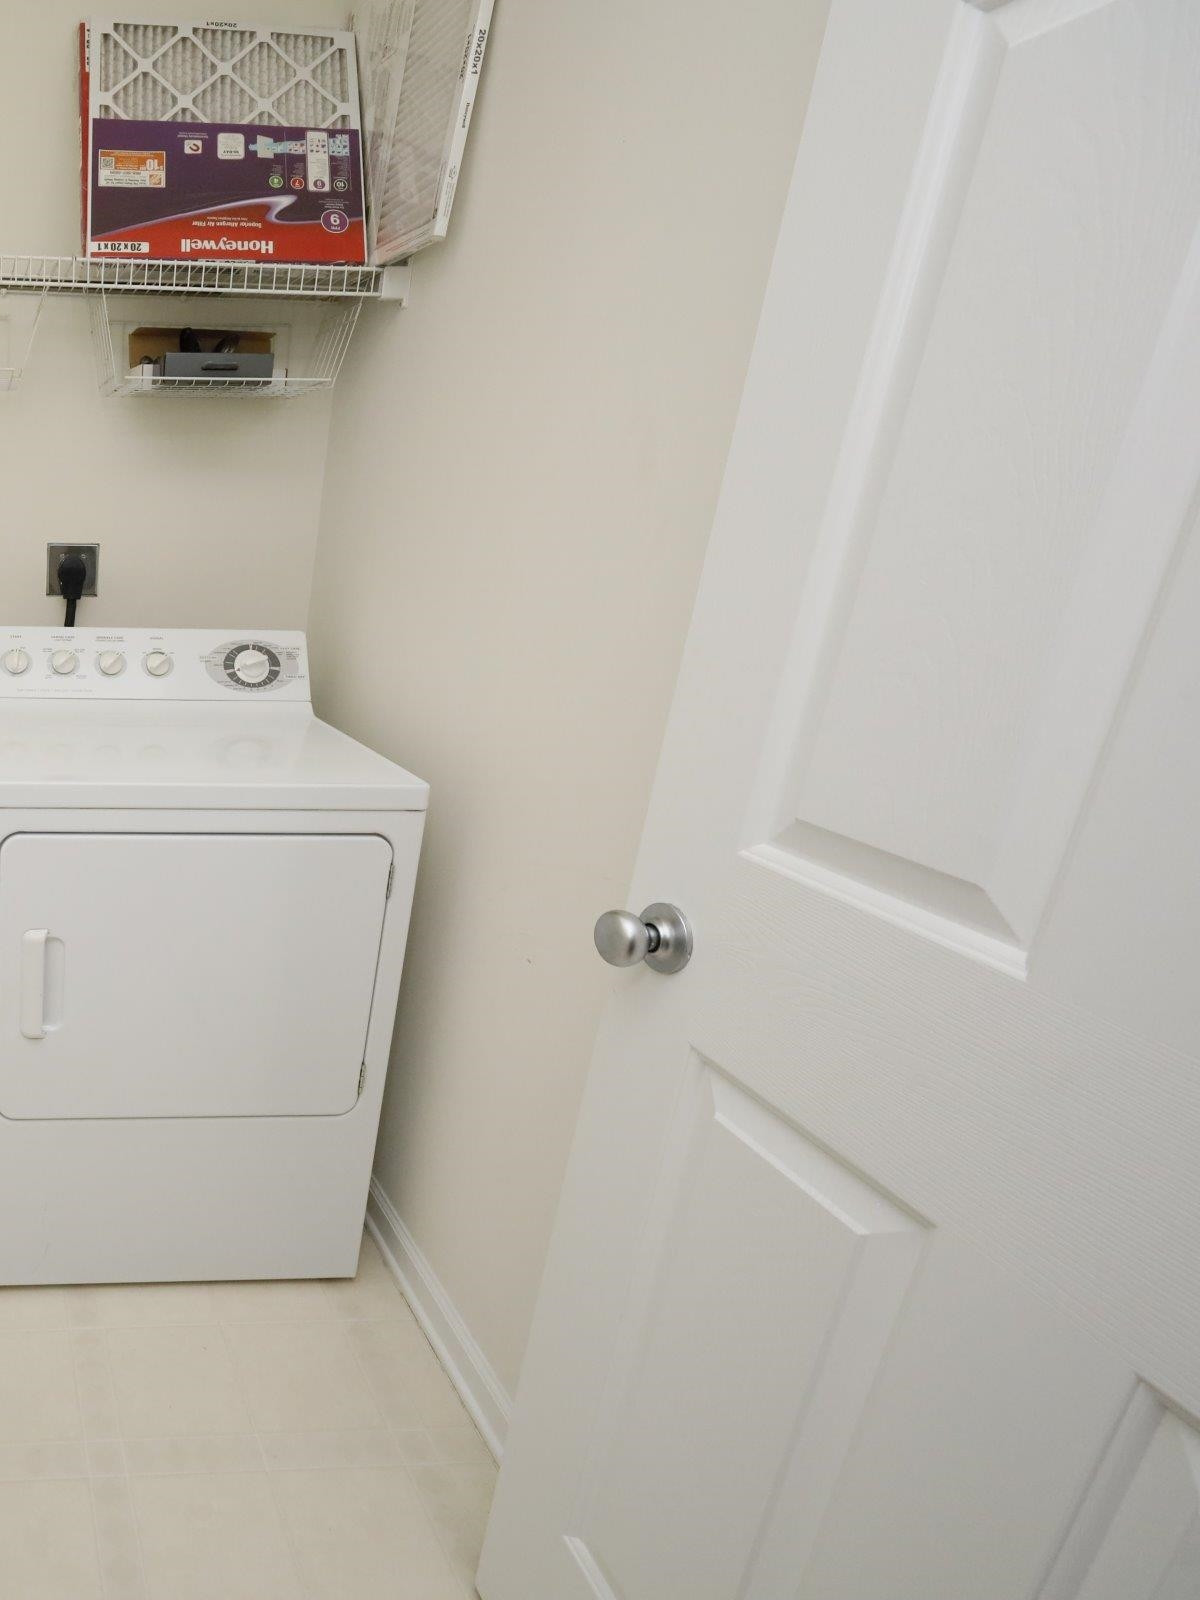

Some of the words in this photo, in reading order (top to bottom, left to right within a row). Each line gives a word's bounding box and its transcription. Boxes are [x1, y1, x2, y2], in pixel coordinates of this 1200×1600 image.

[471, 28, 487, 75] 20x20x1
[216, 220, 239, 228] Allergen
[330, 214, 340, 225] 9
[97, 242, 102, 251] 1
[110, 242, 122, 252] 20
[130, 242, 142, 252] 20
[181, 237, 275, 254] Honeywell
